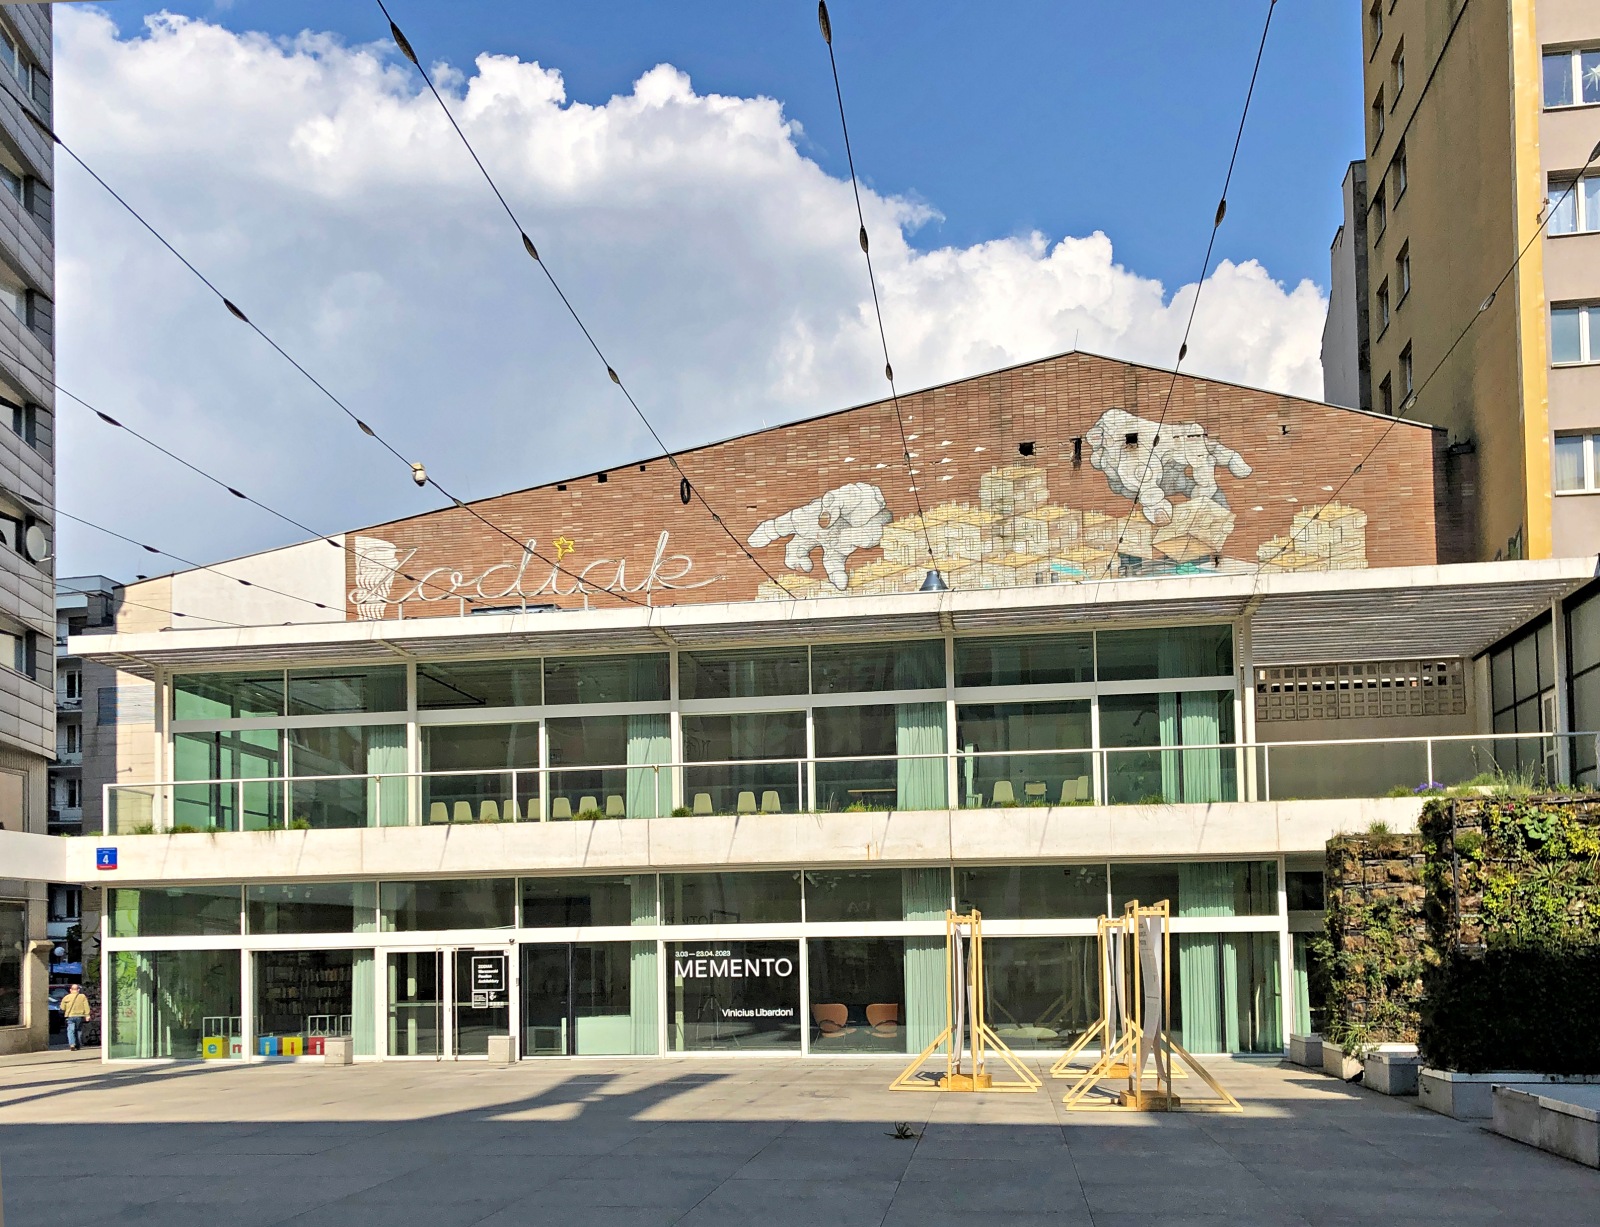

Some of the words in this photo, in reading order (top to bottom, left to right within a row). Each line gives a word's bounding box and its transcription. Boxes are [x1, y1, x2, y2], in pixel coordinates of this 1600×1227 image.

[102, 854, 109, 865] 4
[674, 958, 793, 978] MEMENTO
[721, 1008, 755, 1017] Vinicius
[755, 1007, 794, 1017] Libardoni
